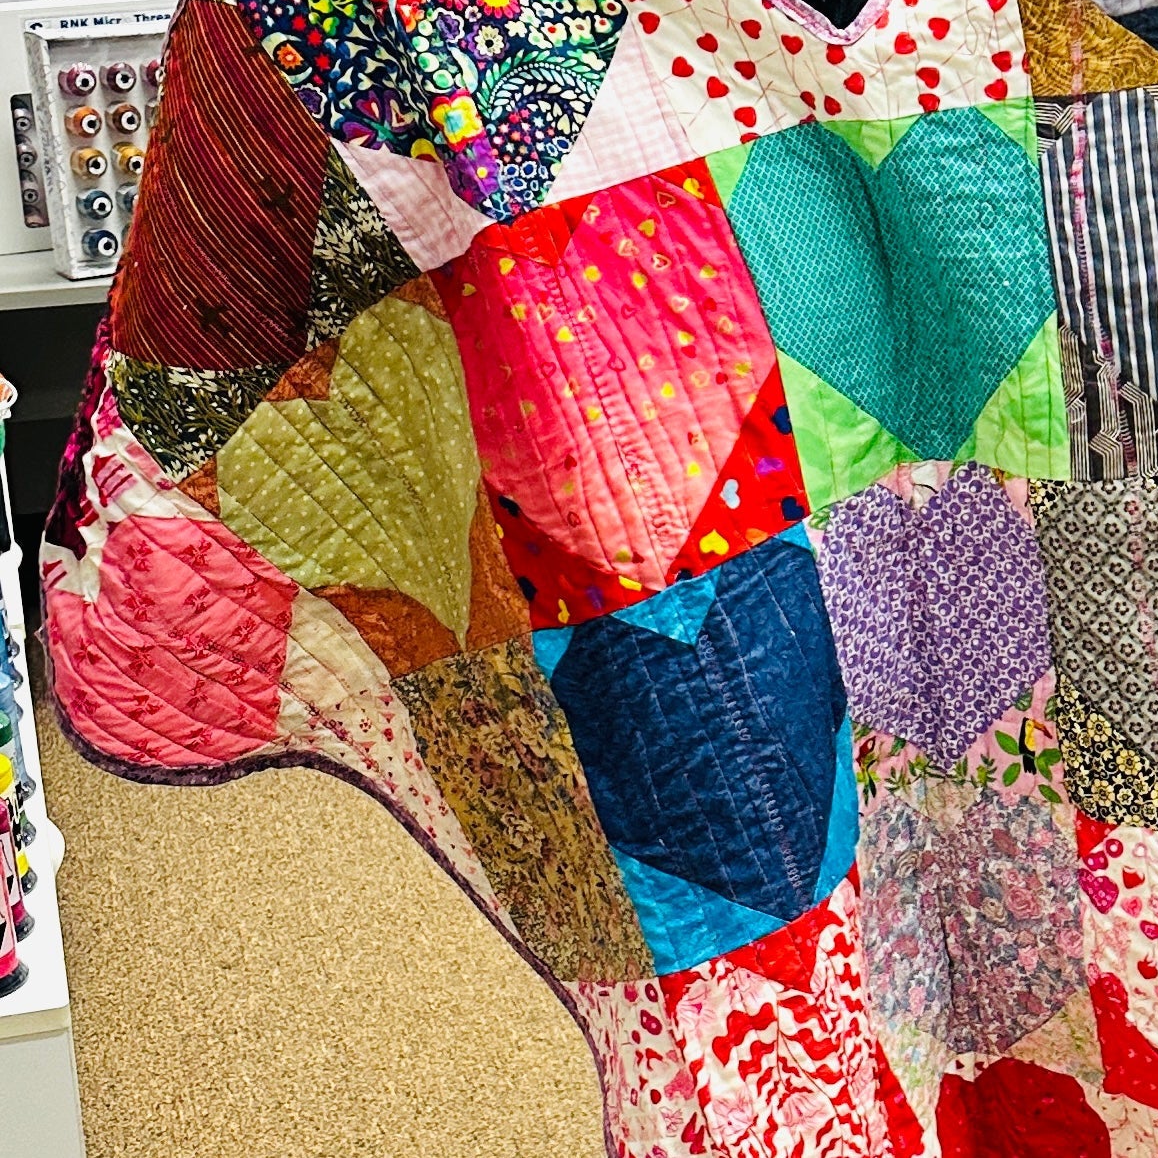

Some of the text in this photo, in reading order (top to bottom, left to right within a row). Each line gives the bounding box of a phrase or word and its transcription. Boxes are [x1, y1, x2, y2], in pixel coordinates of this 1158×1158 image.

[60, 13, 171, 29] RNK Micr Threa
